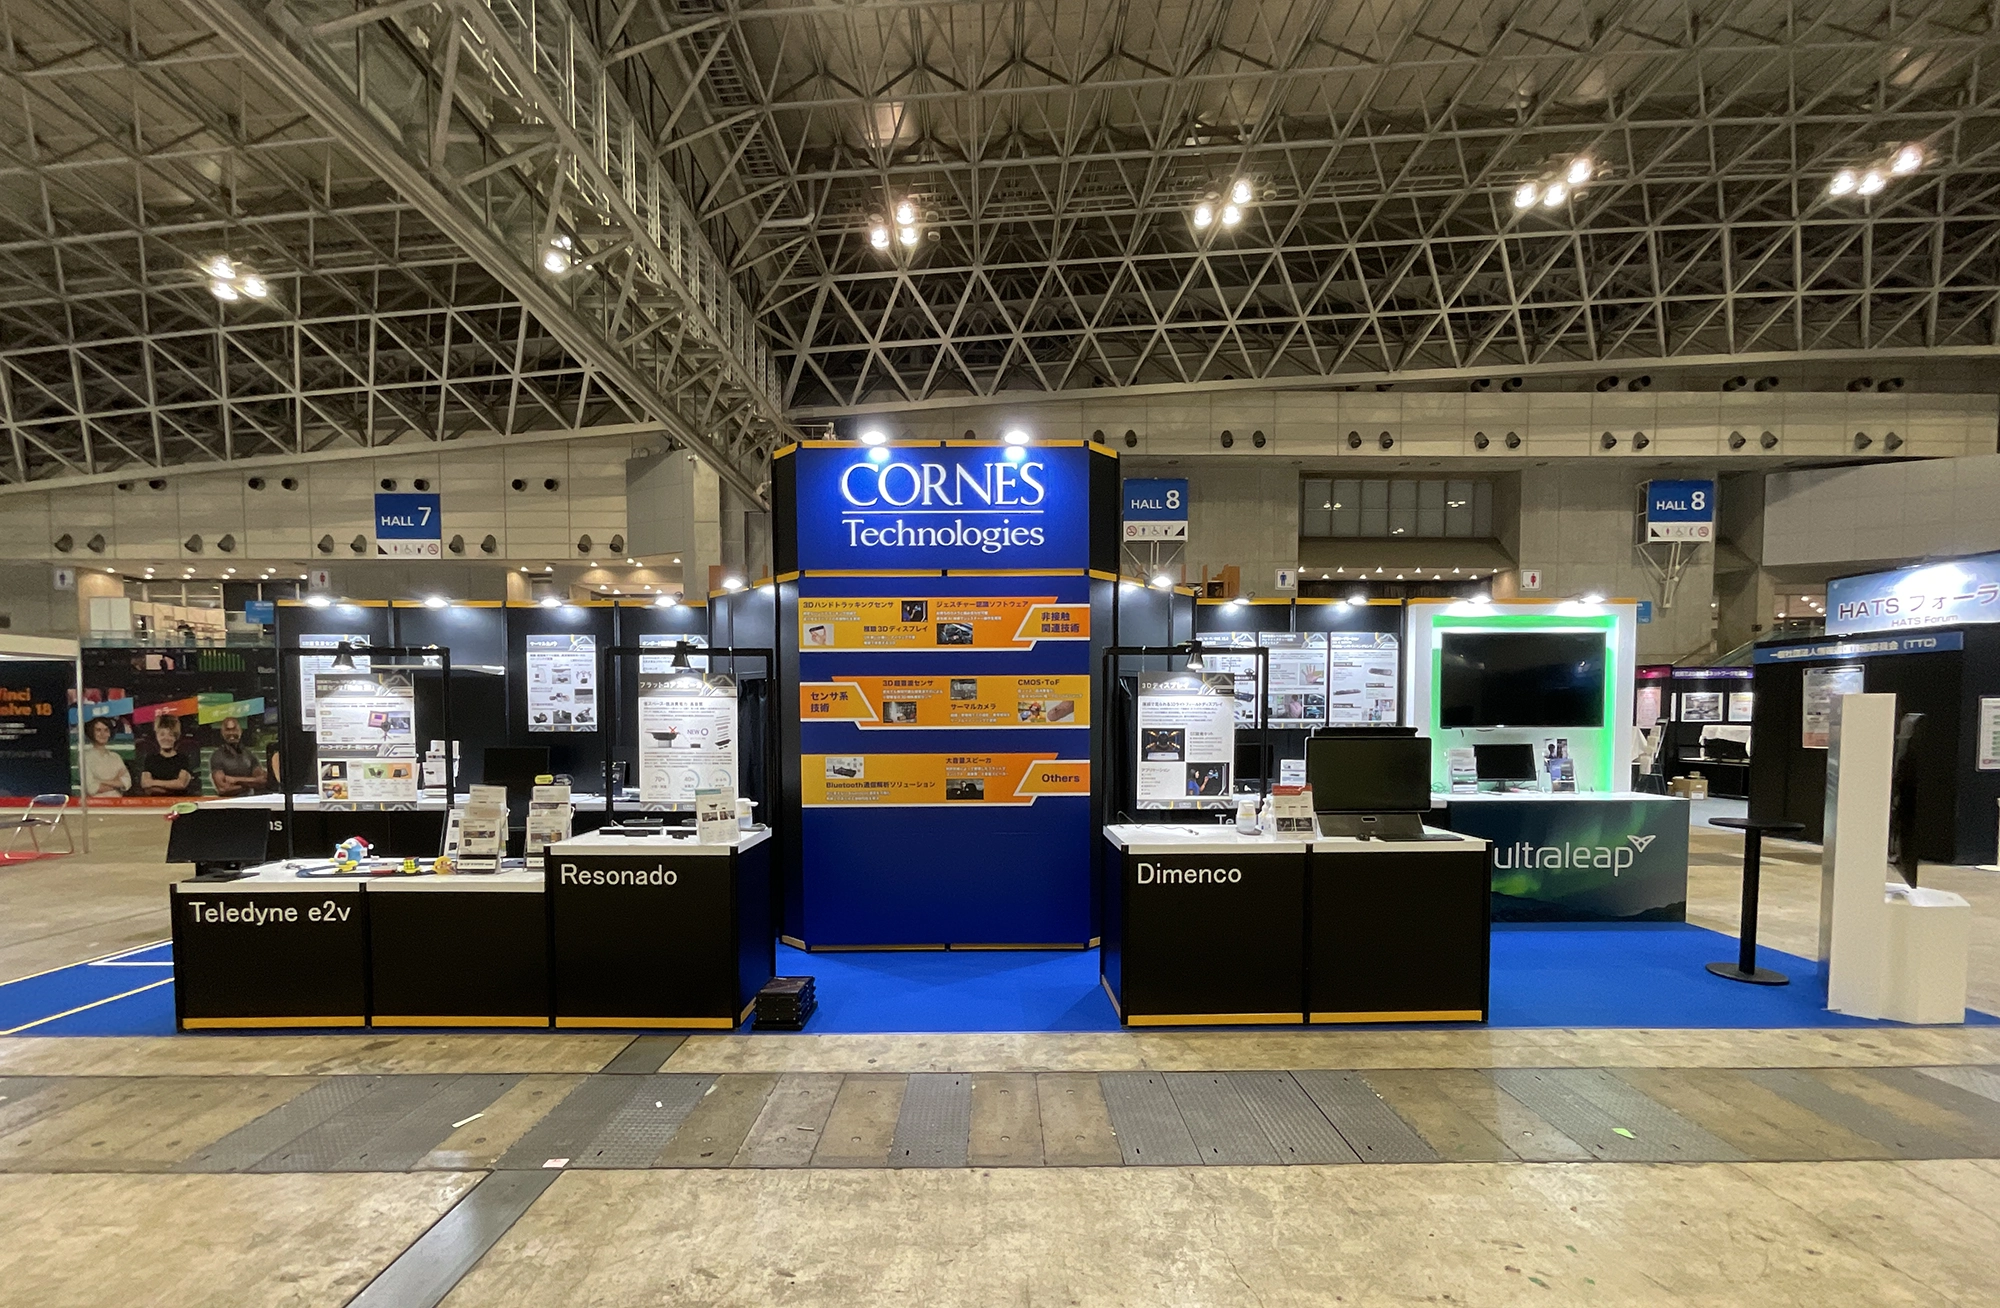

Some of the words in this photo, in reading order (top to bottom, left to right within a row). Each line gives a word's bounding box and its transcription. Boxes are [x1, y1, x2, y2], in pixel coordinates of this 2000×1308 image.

[841, 462, 1045, 507] CORNES
[1131, 500, 1162, 509] HALL
[1166, 490, 1180, 509] 8
[1656, 500, 1688, 510] HALL
[1691, 491, 1706, 510] 8
[381, 516, 414, 526] HALL
[418, 506, 432, 526] 7
[842, 518, 1045, 554] Technologies
[1041, 612, 1070, 621] 非接触
[1838, 597, 1899, 620] HATS
[1041, 624, 1080, 633] 関連技術
[1891, 617, 1921, 627] HATS
[1924, 614, 1958, 625] Forum
[810, 692, 848, 700] センサ系
[35, 704, 52, 716] 18
[810, 703, 830, 712] 技術
[1042, 774, 1080, 783] Others
[1494, 842, 1634, 877] ultraleap
[560, 864, 678, 885] Resonado
[1138, 862, 1242, 884] Dimenco
[189, 902, 298, 926] Teledyne
[308, 900, 351, 922] e2v
